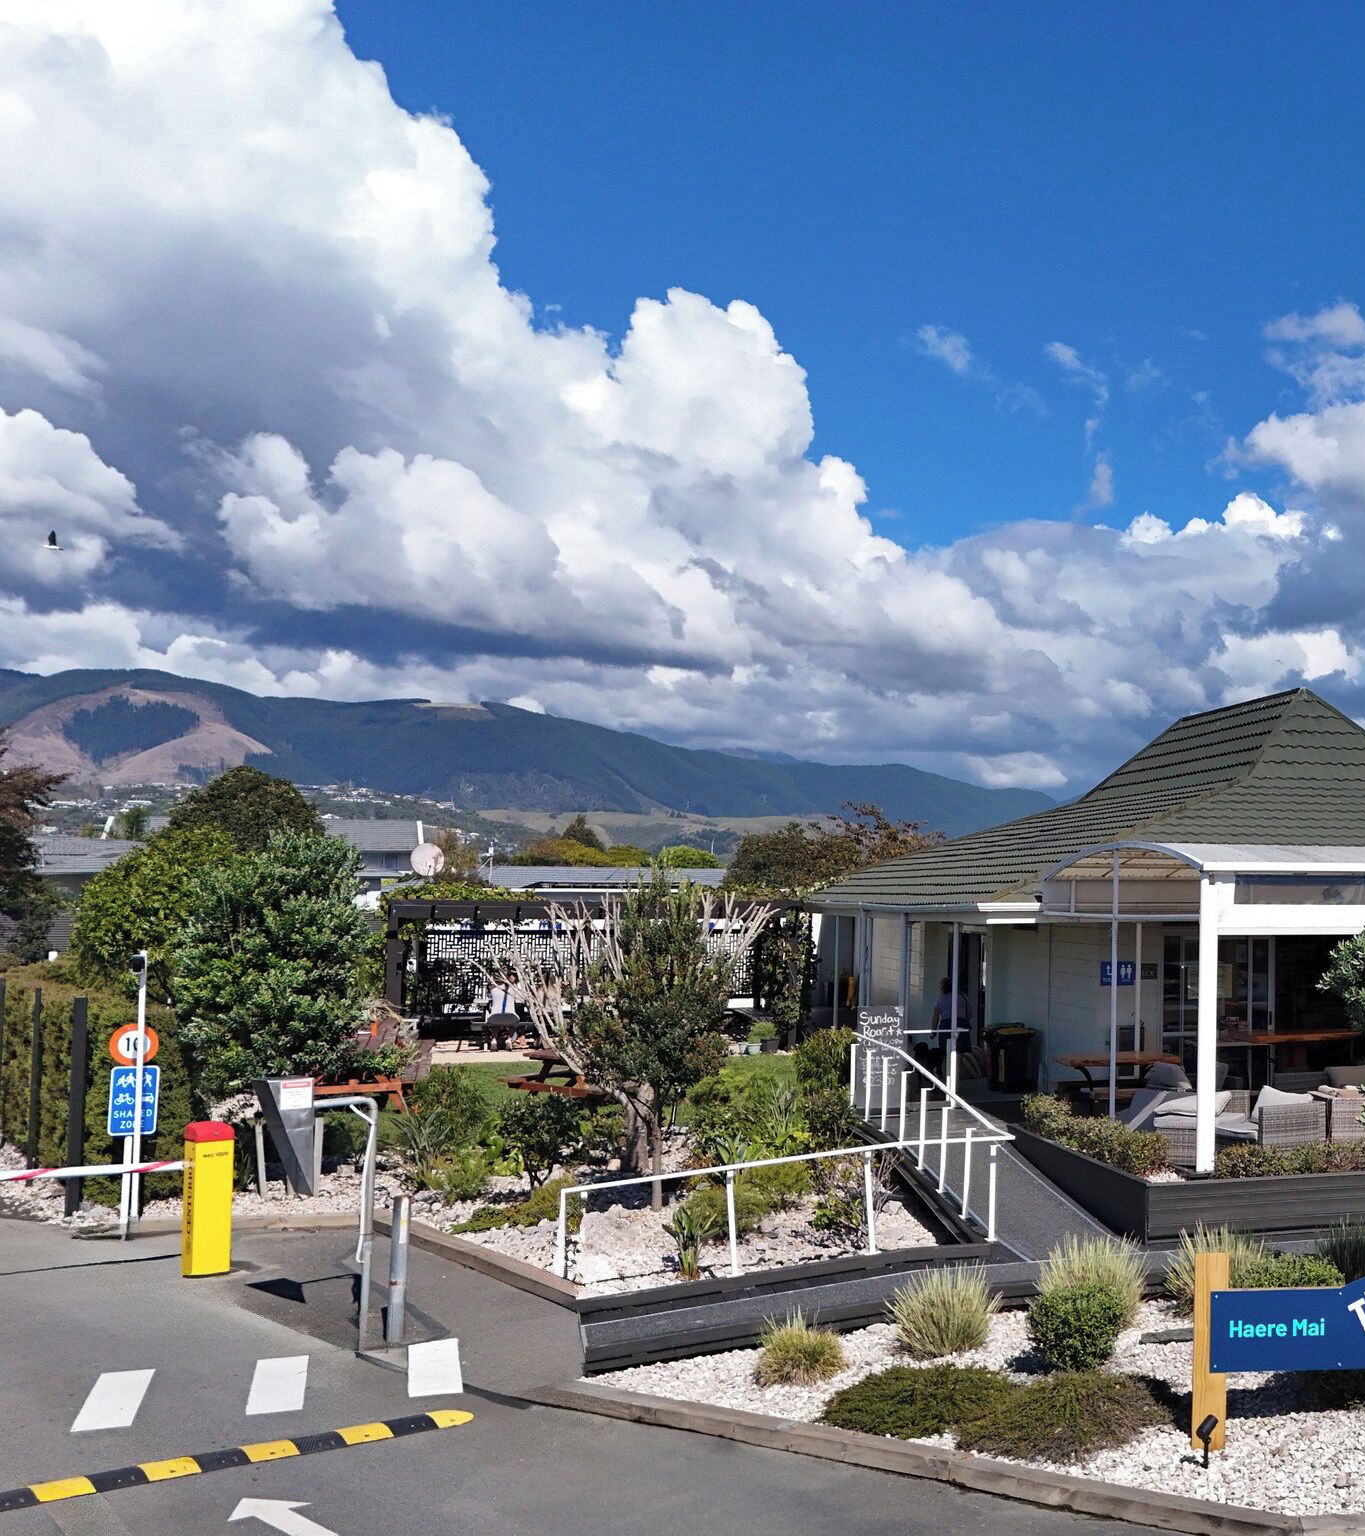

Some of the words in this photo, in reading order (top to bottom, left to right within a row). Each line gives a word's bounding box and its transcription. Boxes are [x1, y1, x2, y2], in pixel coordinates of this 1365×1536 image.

[860, 1011, 900, 1027] Sunday
[863, 1025, 893, 1038] Roast
[1229, 1319, 1288, 1338] Haere
[1292, 1318, 1326, 1337] Mai
